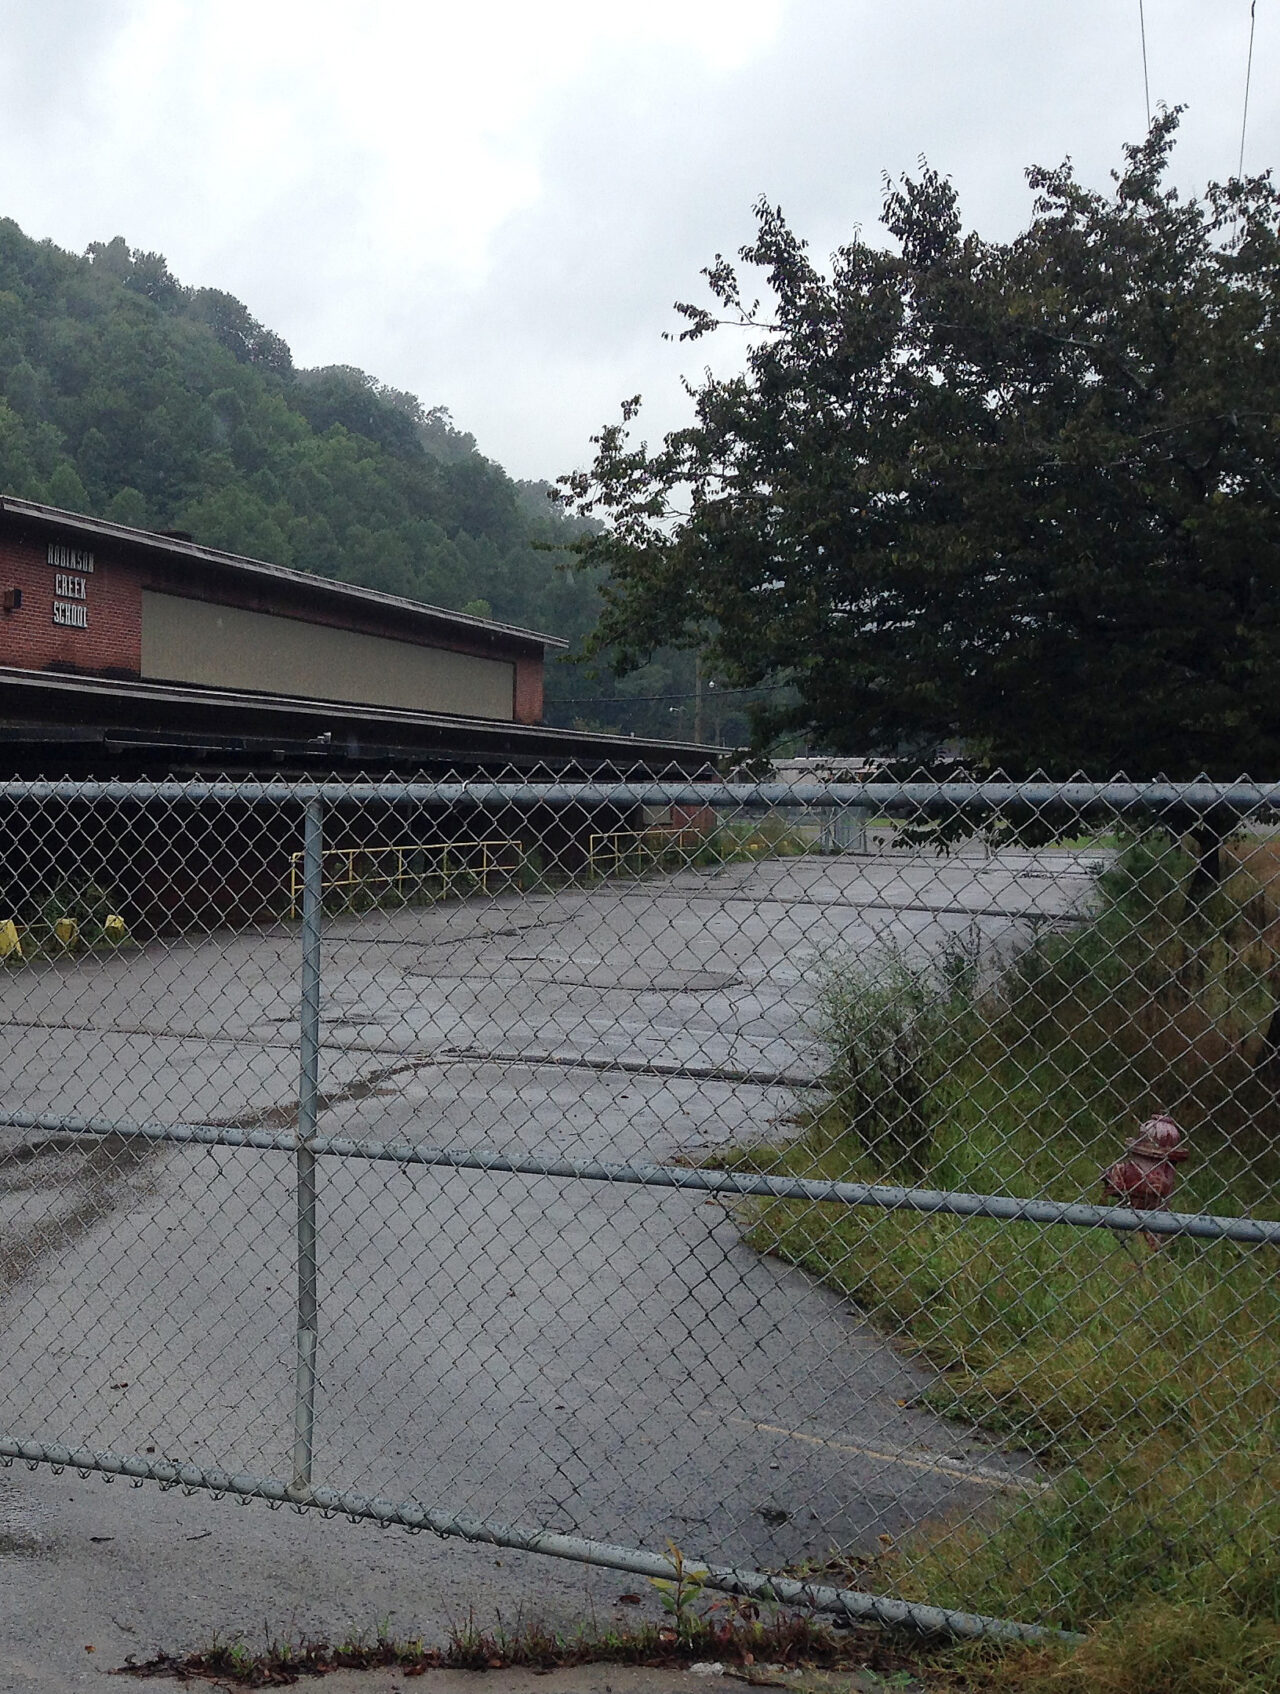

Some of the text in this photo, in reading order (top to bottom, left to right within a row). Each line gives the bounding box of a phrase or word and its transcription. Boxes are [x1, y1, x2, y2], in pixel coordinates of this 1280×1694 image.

[48, 544, 94, 573] ROBINSON
[56, 574, 86, 600] CREEK
[53, 601, 88, 628] SCHOOL
